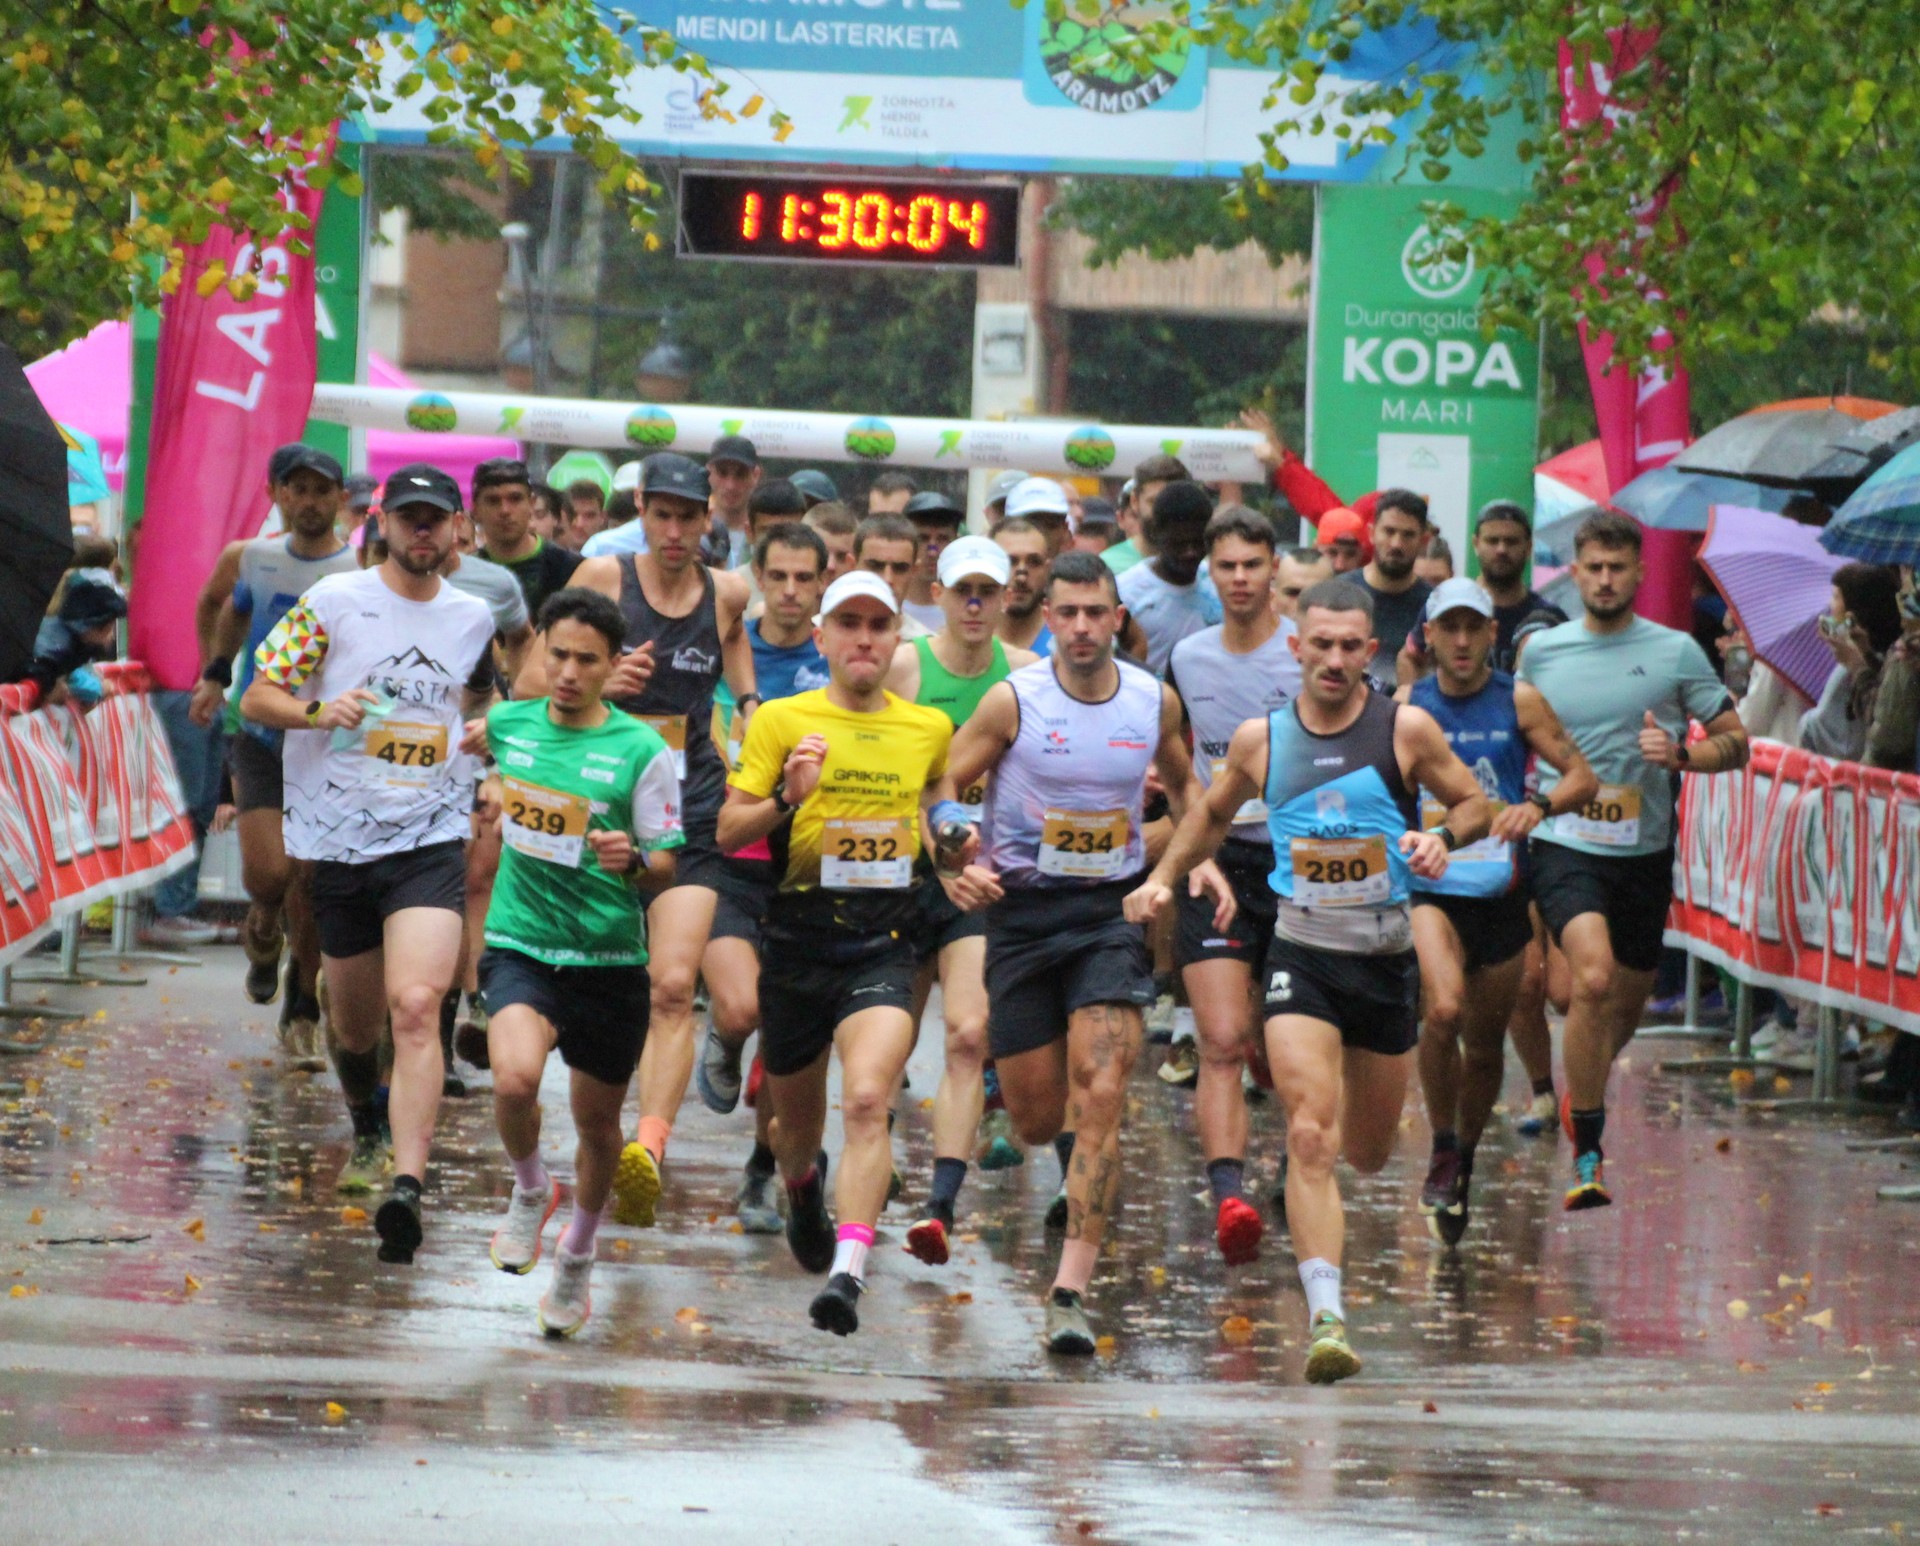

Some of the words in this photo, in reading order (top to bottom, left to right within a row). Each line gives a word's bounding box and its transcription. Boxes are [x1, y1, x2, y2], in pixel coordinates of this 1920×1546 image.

[676, 15, 767, 41] MENDI
[775, 20, 960, 48] LASTERKETA
[1052, 69, 1171, 113] ARAMOTZ
[880, 111, 922, 124] MENDI
[880, 125, 930, 139] TALDEA
[742, 191, 987, 252] 11:30:04
[1344, 303, 1481, 337] Durangald
[1342, 336, 1523, 390] KOPA
[375, 741, 437, 768] 478
[509, 801, 567, 836] 239
[1582, 800, 1623, 824] 80
[836, 837, 898, 863] 232
[1055, 830, 1114, 855] 234
[1305, 859, 1369, 884] 280
